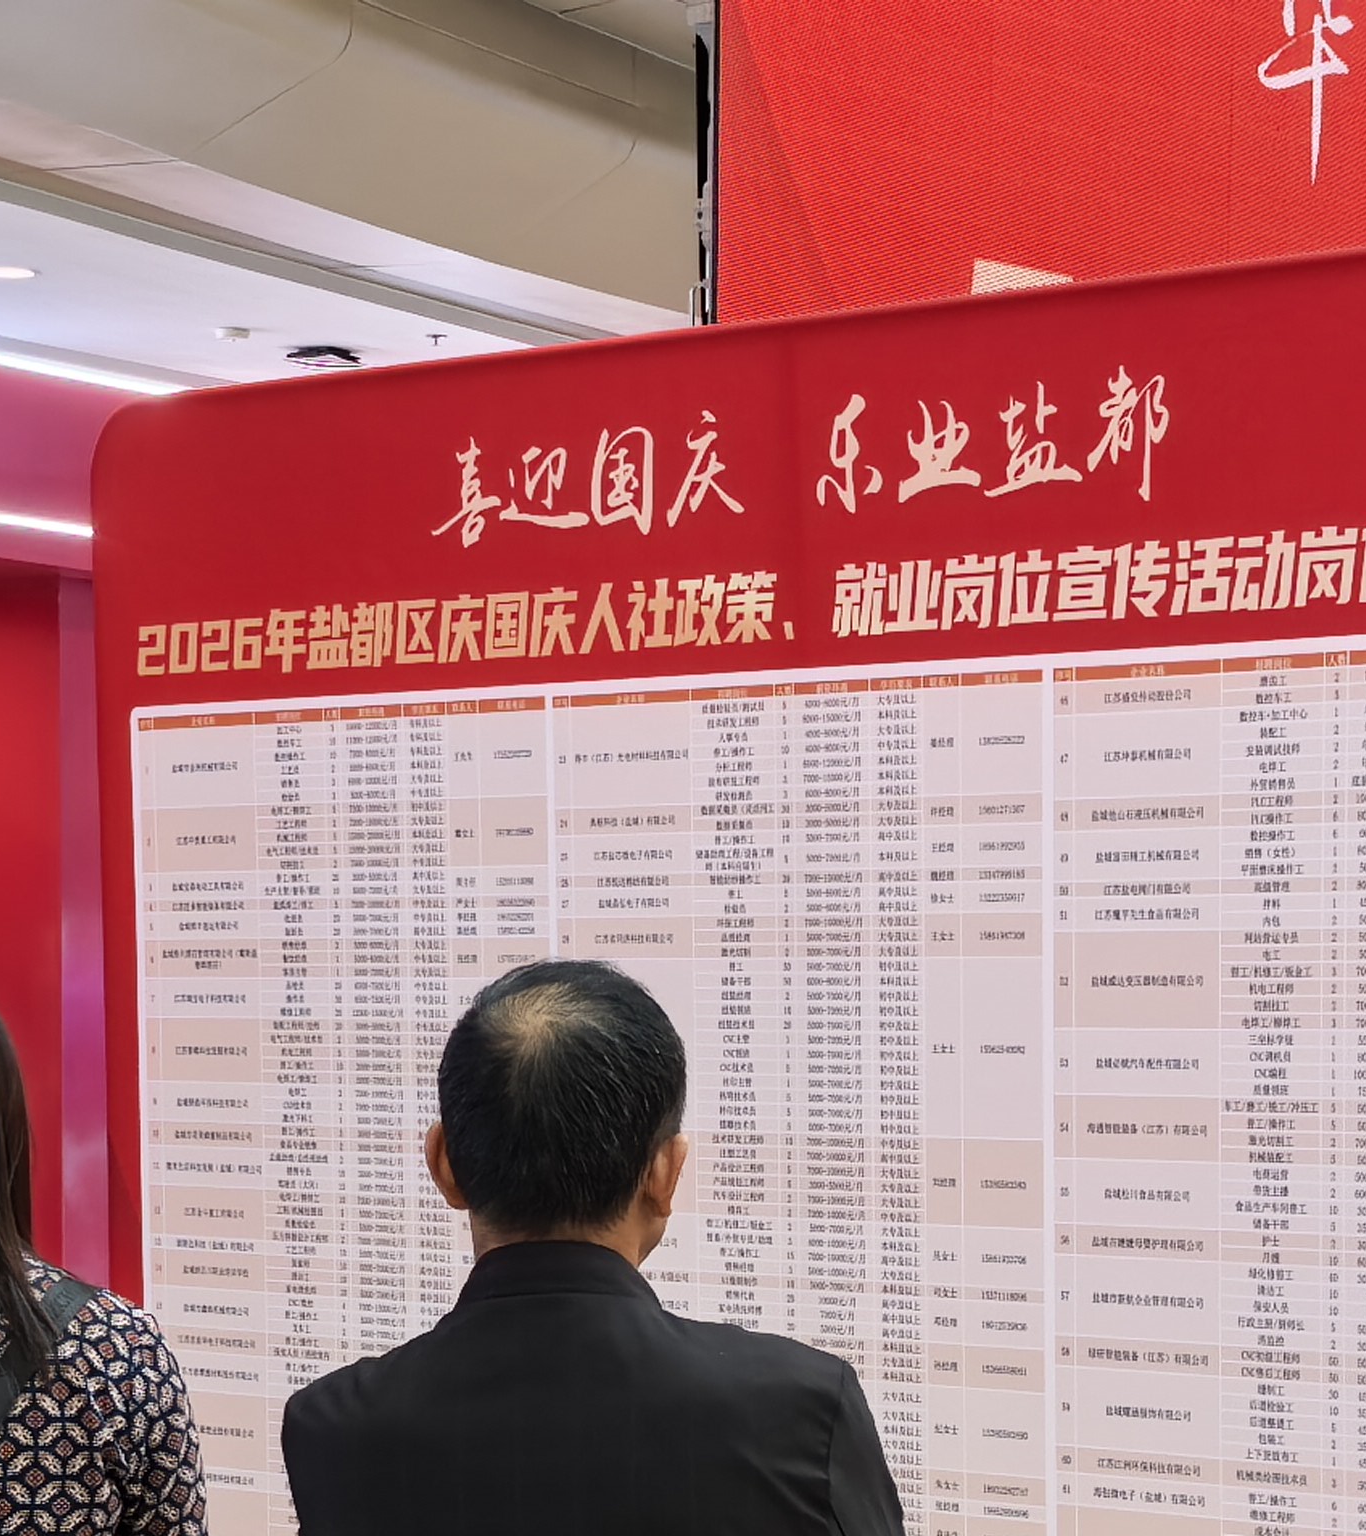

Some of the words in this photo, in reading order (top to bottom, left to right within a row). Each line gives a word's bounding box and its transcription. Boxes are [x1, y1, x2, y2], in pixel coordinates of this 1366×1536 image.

[432, 426, 744, 548] 喜迎国庆
[816, 365, 1169, 512] 乐业盐都
